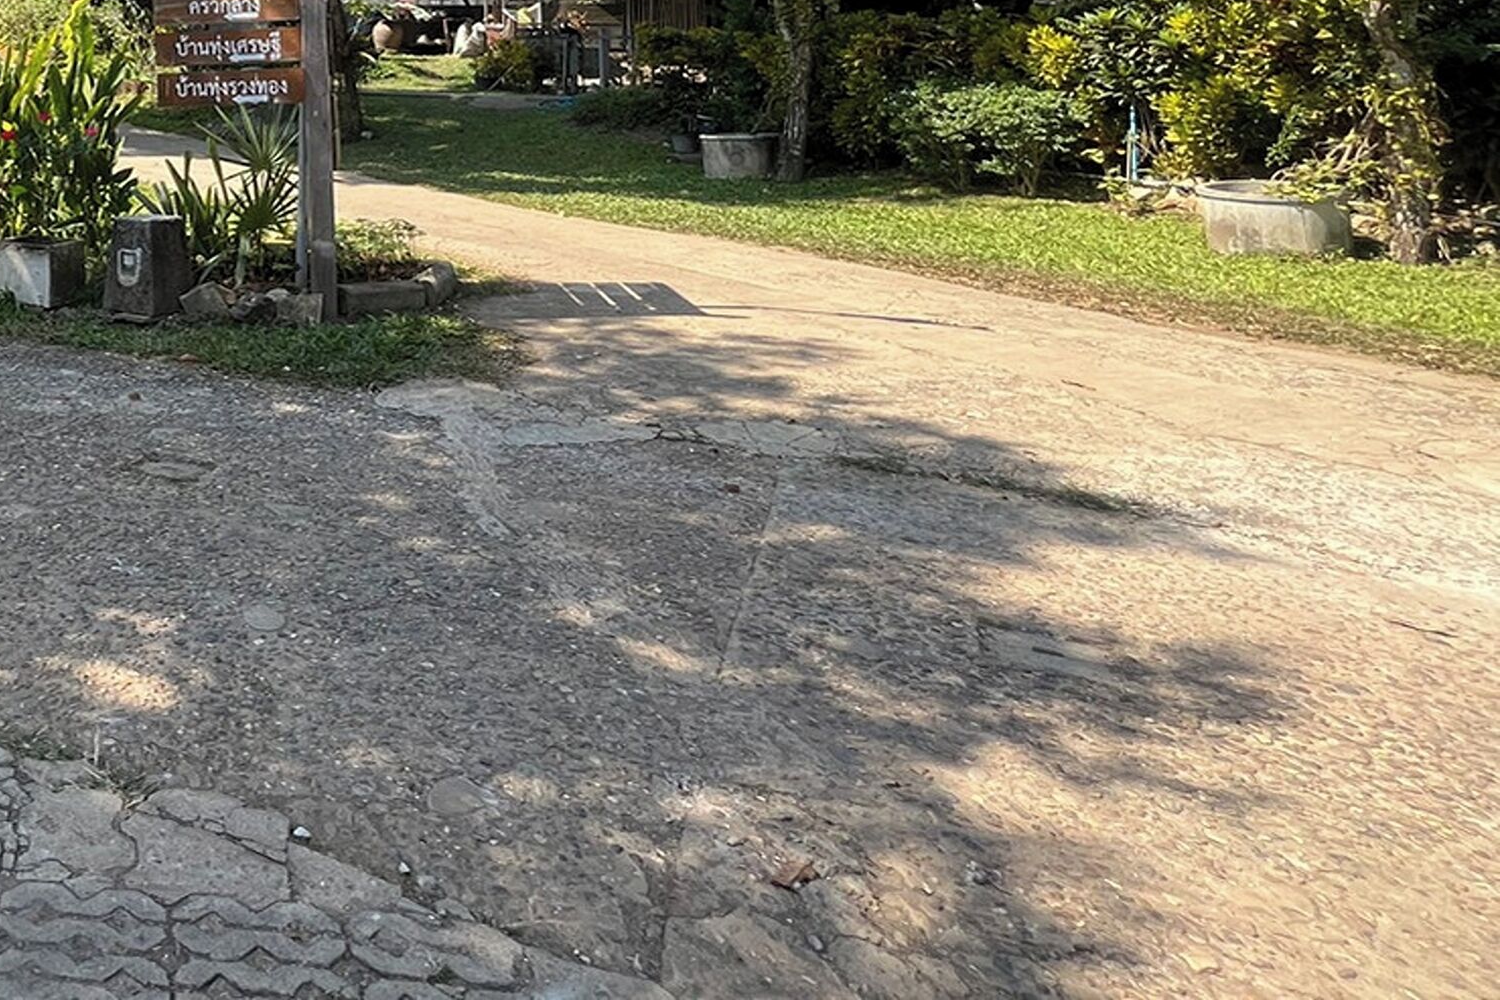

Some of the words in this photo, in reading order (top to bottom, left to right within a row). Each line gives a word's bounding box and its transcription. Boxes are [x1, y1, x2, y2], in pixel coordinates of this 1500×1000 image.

[175, 31, 281, 60] บ้านทุ่งเศรษฐี
[175, 75, 288, 102] บ้านทุ่งรวงทอง
